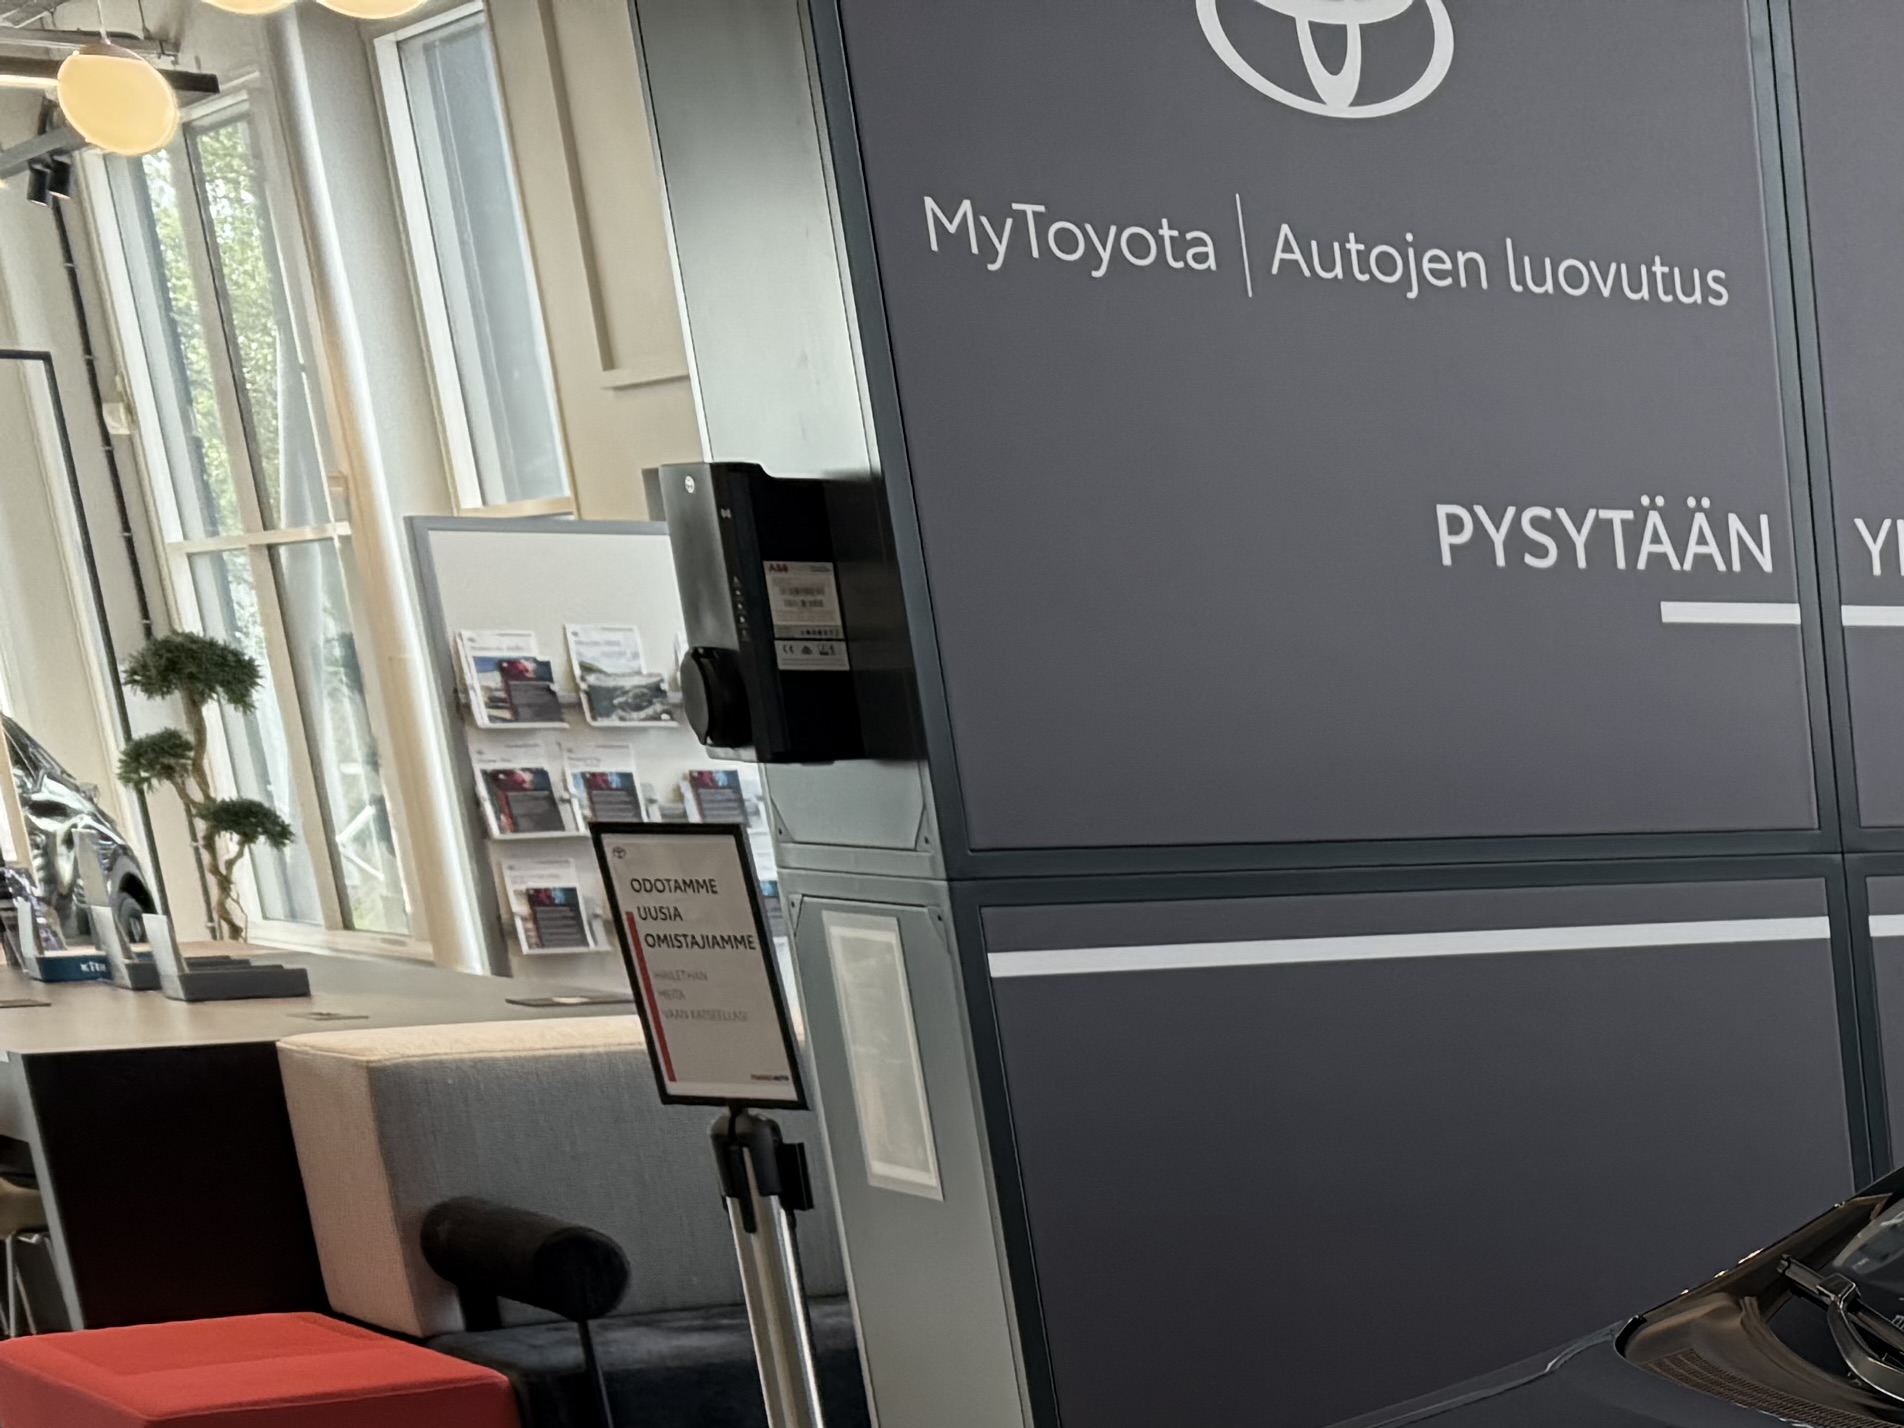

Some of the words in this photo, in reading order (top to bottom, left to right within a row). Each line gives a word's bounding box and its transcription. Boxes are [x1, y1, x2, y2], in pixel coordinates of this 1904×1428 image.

[922, 195, 1217, 278] MyToyota
[1270, 222, 1489, 300] Autojen
[1504, 237, 1730, 308] luovutus
[1435, 494, 1775, 574] PYSYTÄÄN
[630, 877, 719, 895] ODOTAMME
[637, 905, 684, 922] UUSIA
[644, 932, 758, 951] OMISTAJIAMME
